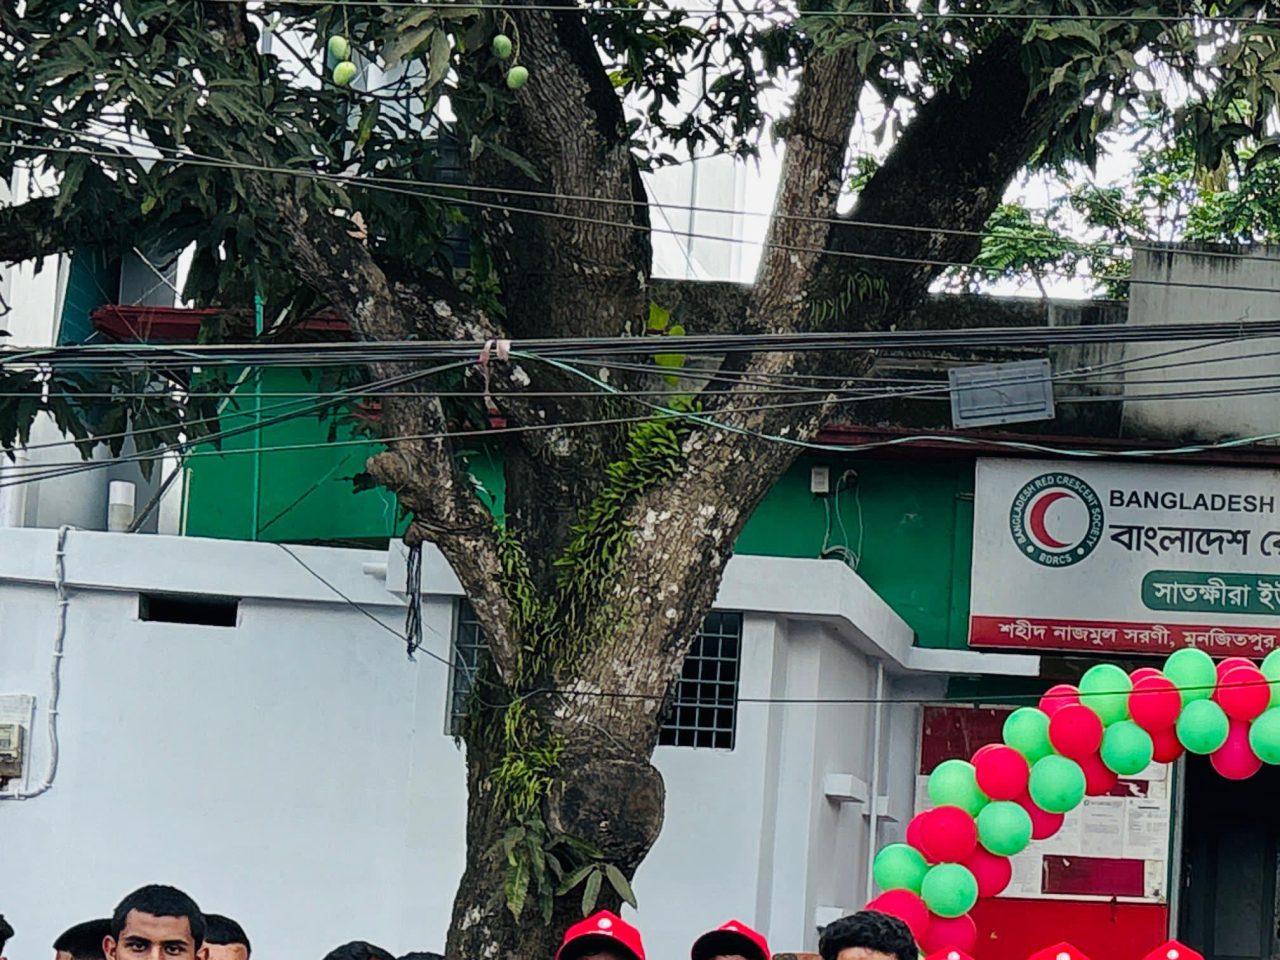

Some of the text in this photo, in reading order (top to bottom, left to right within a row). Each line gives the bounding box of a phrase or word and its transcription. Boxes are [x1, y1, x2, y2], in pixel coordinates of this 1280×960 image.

[1012, 475, 1101, 547] BANGLADESH RED CRESCENT SOCIETY
[1109, 489, 1275, 514] BANGLADESH
[1109, 524, 1251, 556] বাংলাদেশ
[1039, 552, 1072, 565] BDRCS
[1153, 577, 1251, 608] সাতক্ষীরা
[998, 619, 1047, 641] শহীদ
[1053, 625, 1117, 646] নাজমুল
[1123, 625, 1176, 649] সরণী,
